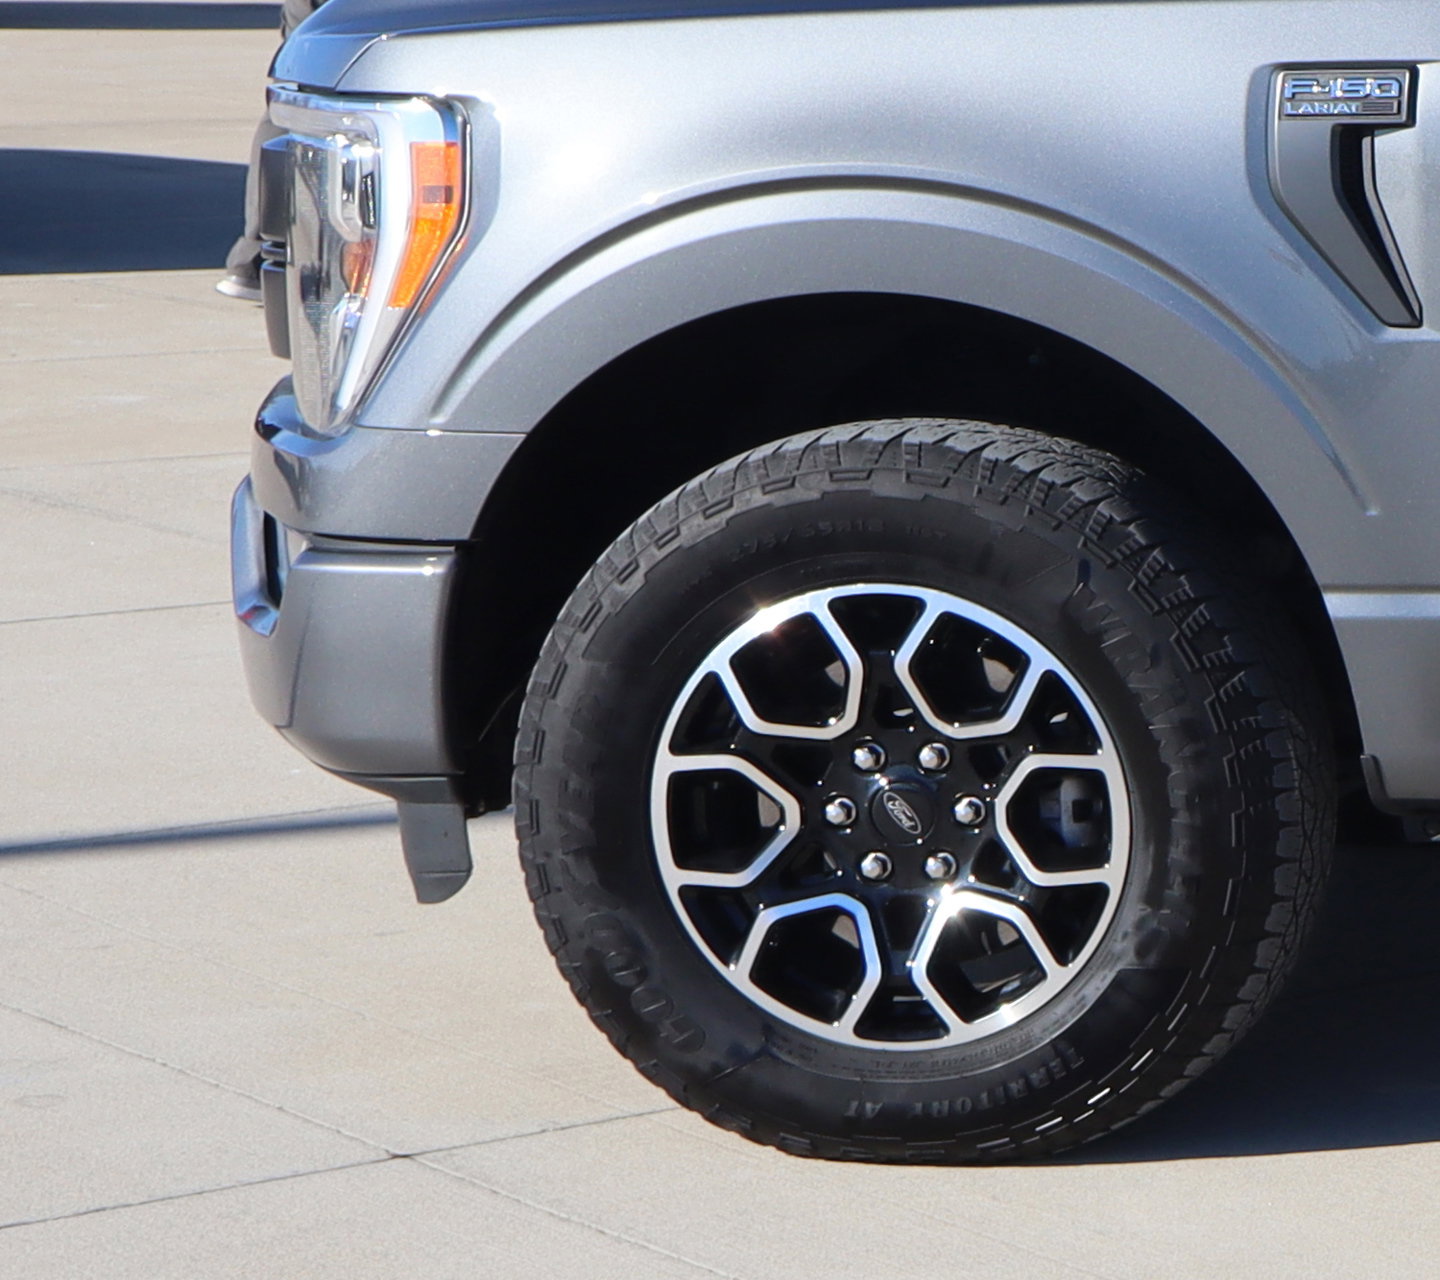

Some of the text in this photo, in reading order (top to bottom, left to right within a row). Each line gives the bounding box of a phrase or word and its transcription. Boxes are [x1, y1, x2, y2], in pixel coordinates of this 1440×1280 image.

[1284, 78, 1401, 100] F-150
[1284, 102, 1358, 115] LARIAT
[1066, 580, 1206, 900] WRANGLER
[907, 1047, 1085, 1118] TERRITORY
